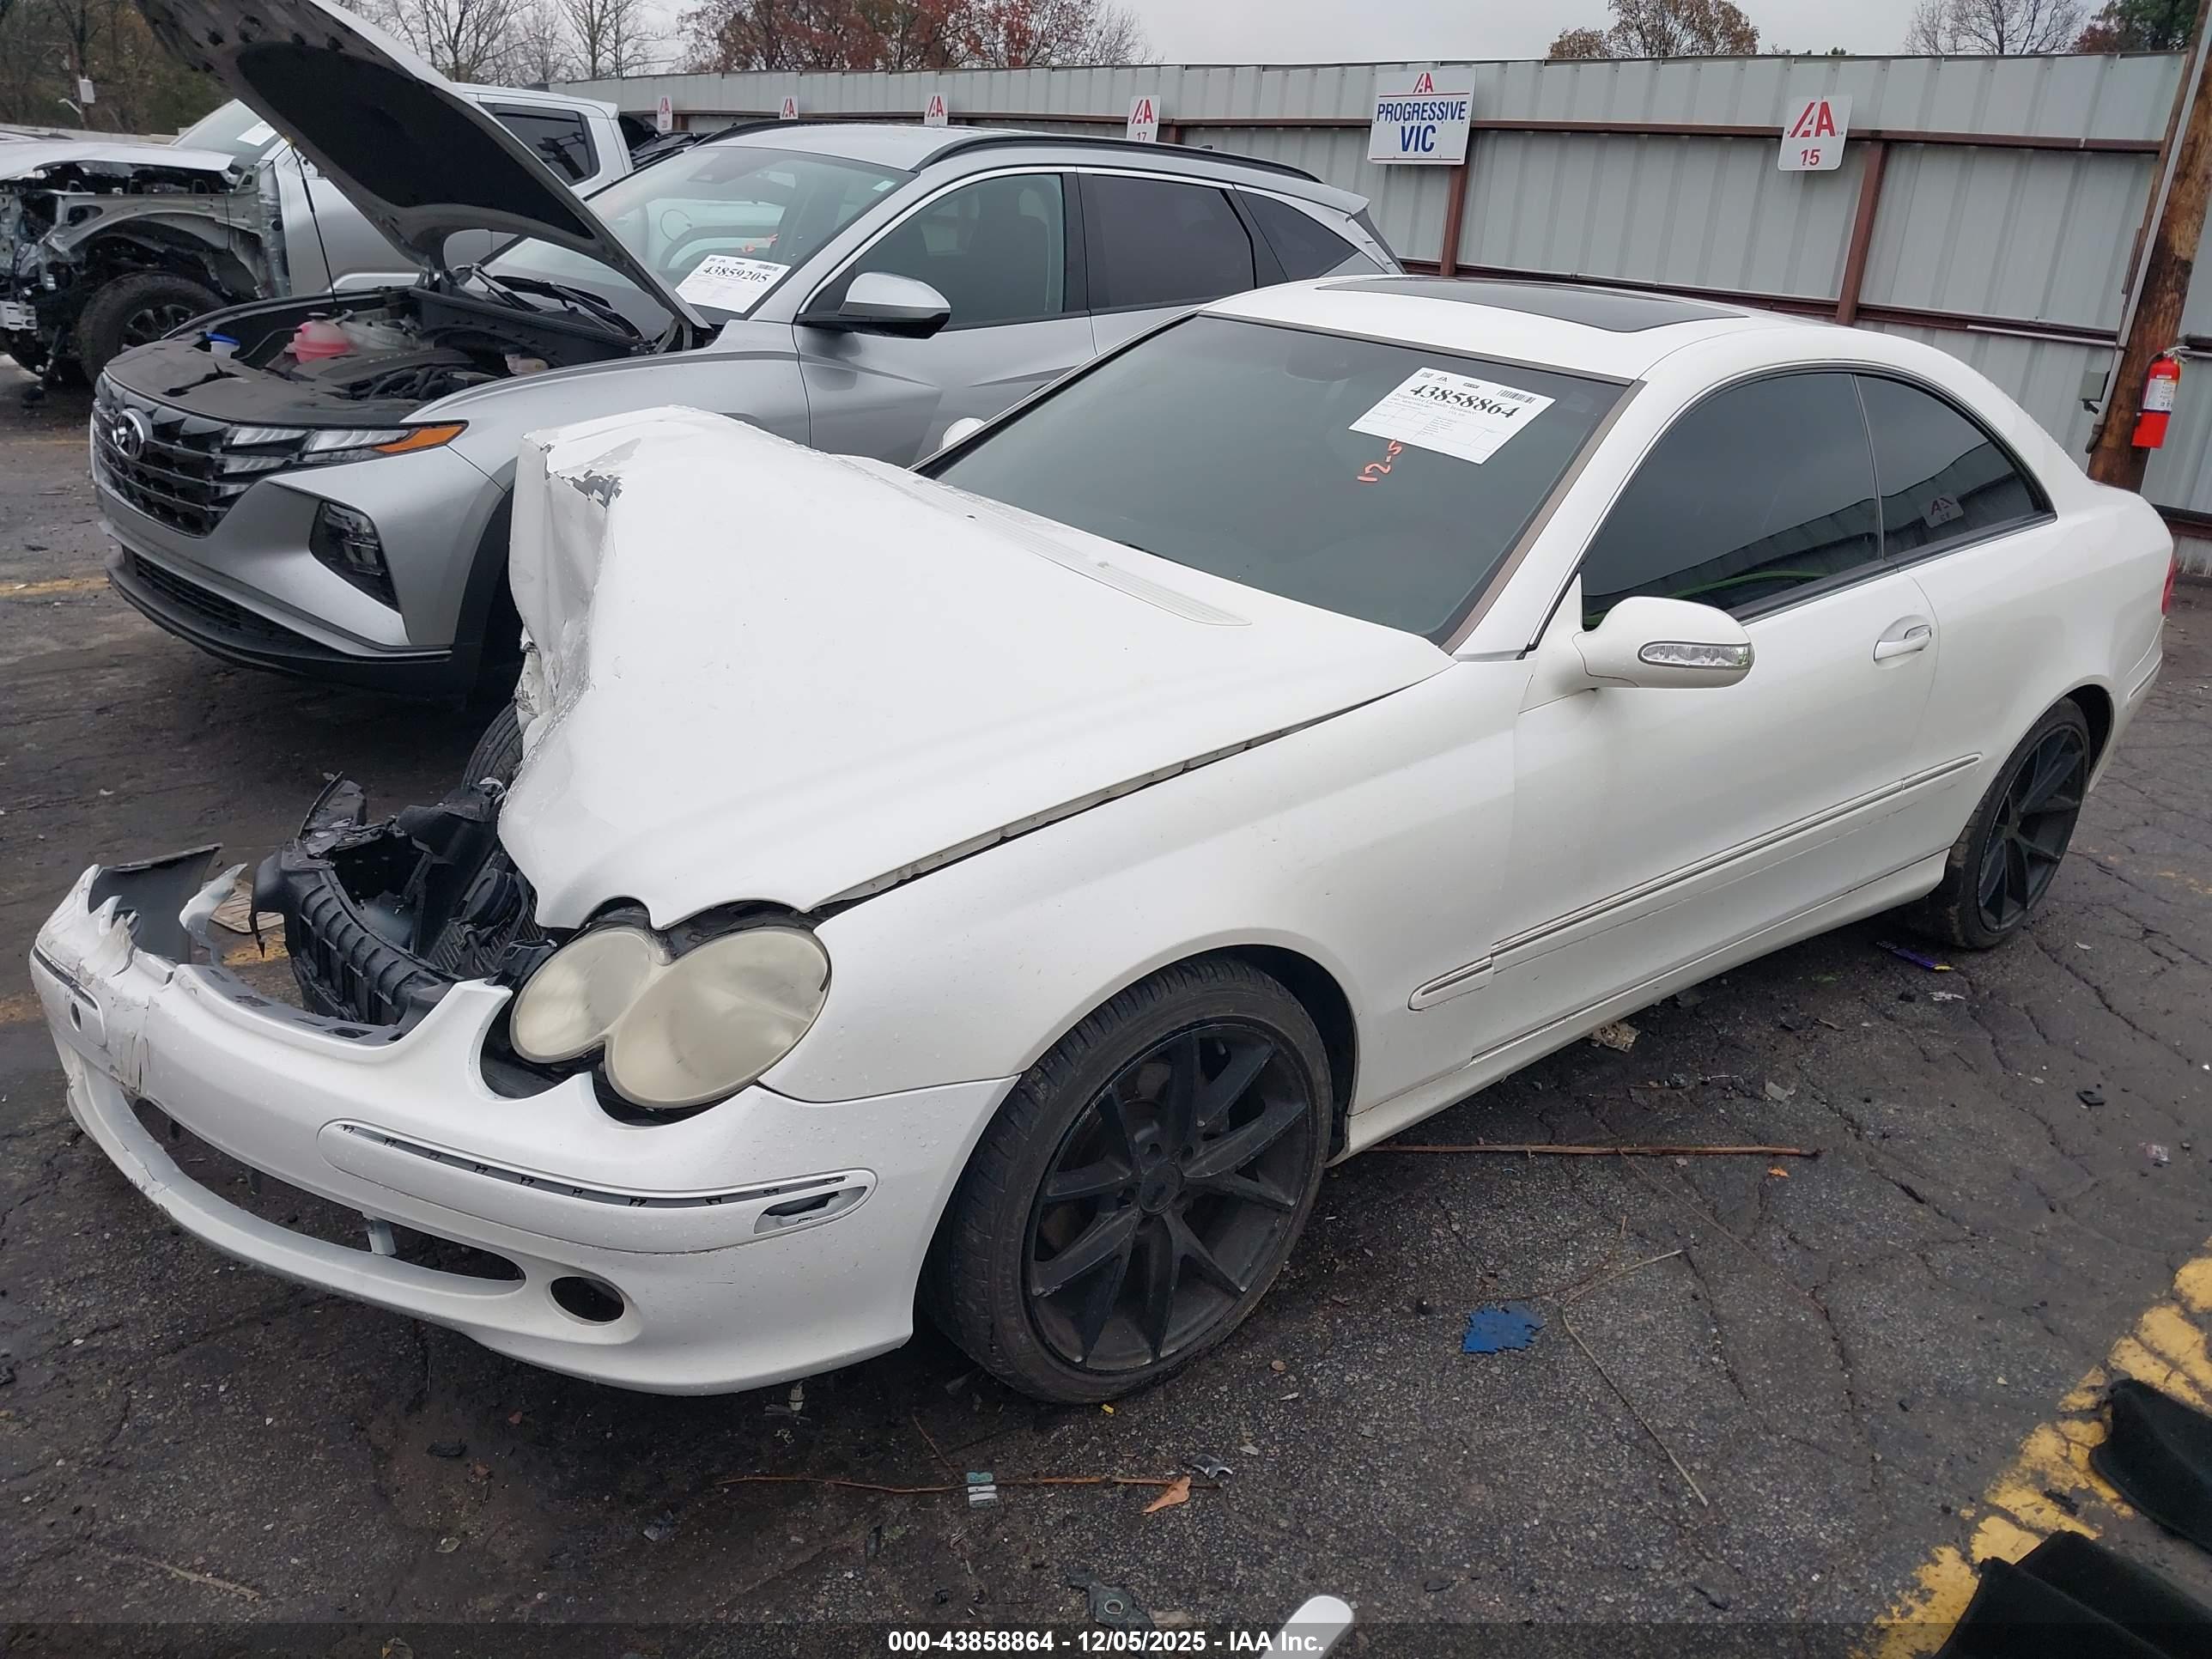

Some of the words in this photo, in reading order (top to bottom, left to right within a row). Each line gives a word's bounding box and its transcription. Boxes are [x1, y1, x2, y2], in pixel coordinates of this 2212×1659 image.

[1376, 100, 1468, 122] PROGRESSIVE
[1136, 131, 1147, 142] 17
[1401, 125, 1437, 152] VIC
[1801, 149, 1821, 167] 15
[703, 264, 771, 283] 43859205
[1409, 384, 1521, 419] 43858864
